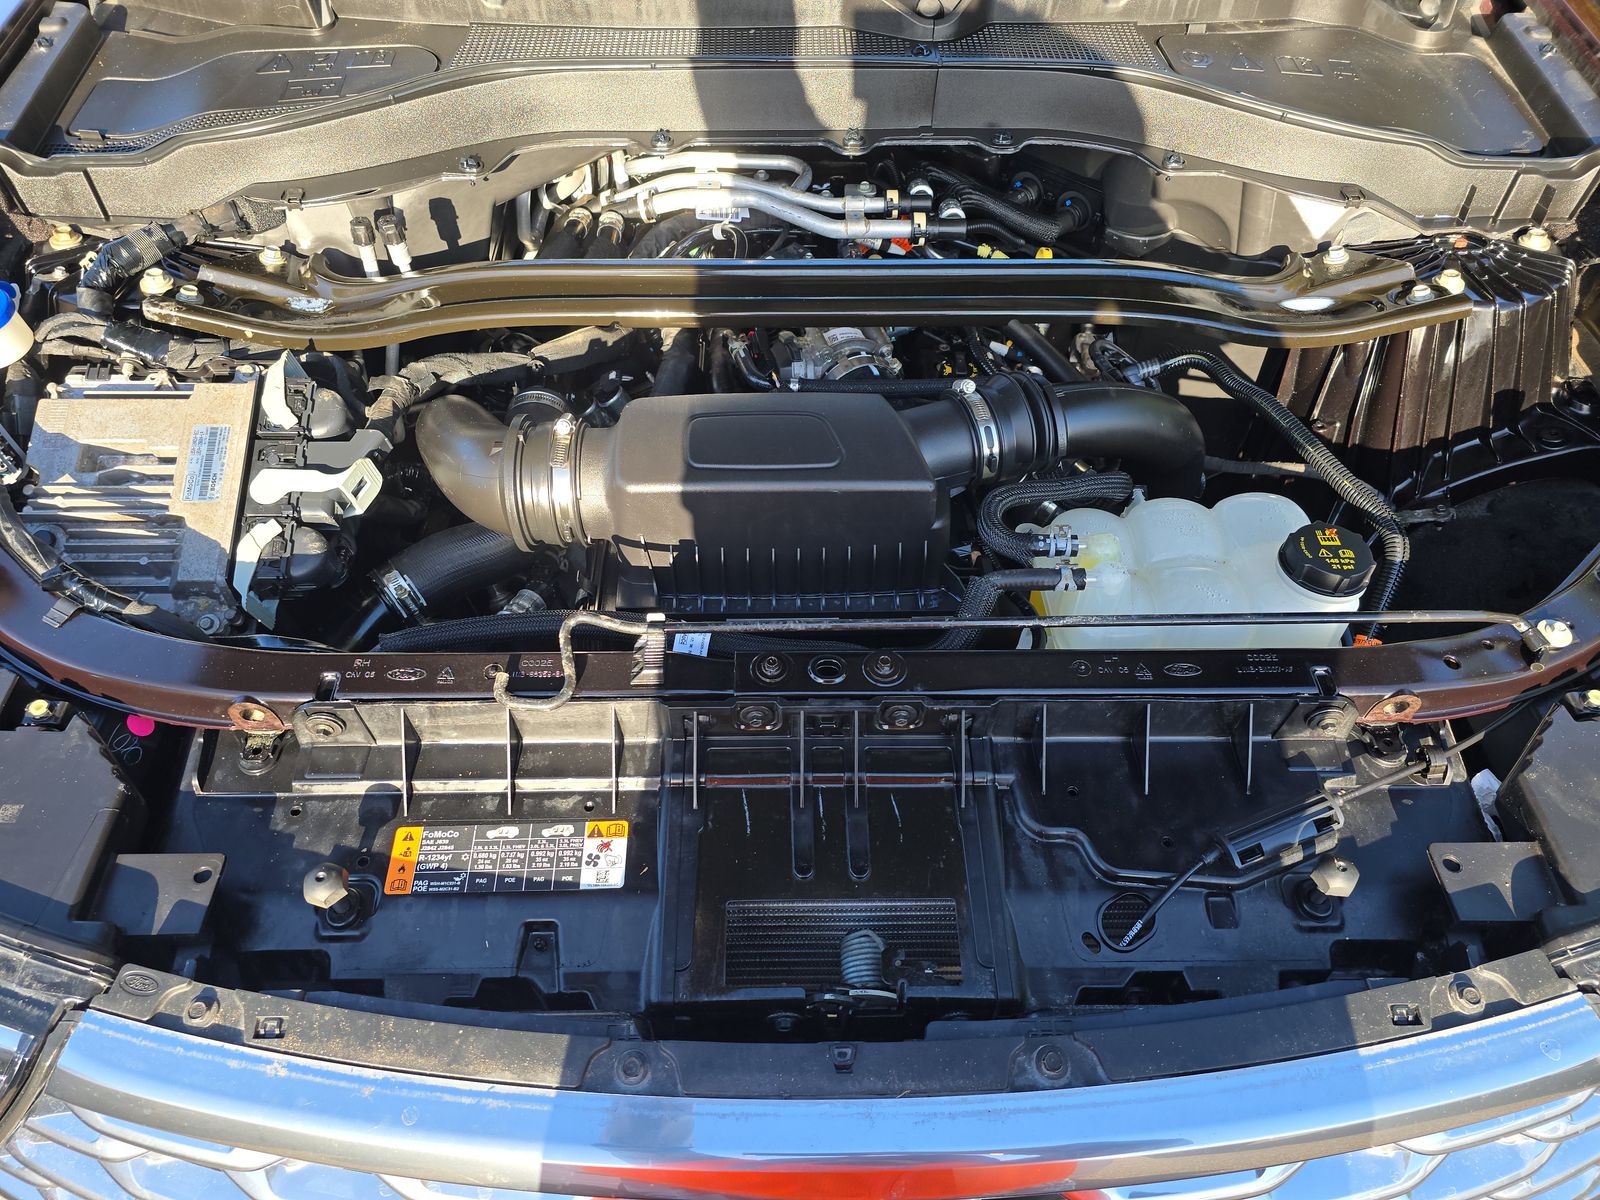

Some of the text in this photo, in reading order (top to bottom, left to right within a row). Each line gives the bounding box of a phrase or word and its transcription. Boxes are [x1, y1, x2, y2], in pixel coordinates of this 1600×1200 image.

[185, 475, 195, 499] FoMoCo
[423, 830, 459, 838] FoMoCo
[419, 854, 452, 862] R-1234yf
[417, 863, 439, 871] (GWP
